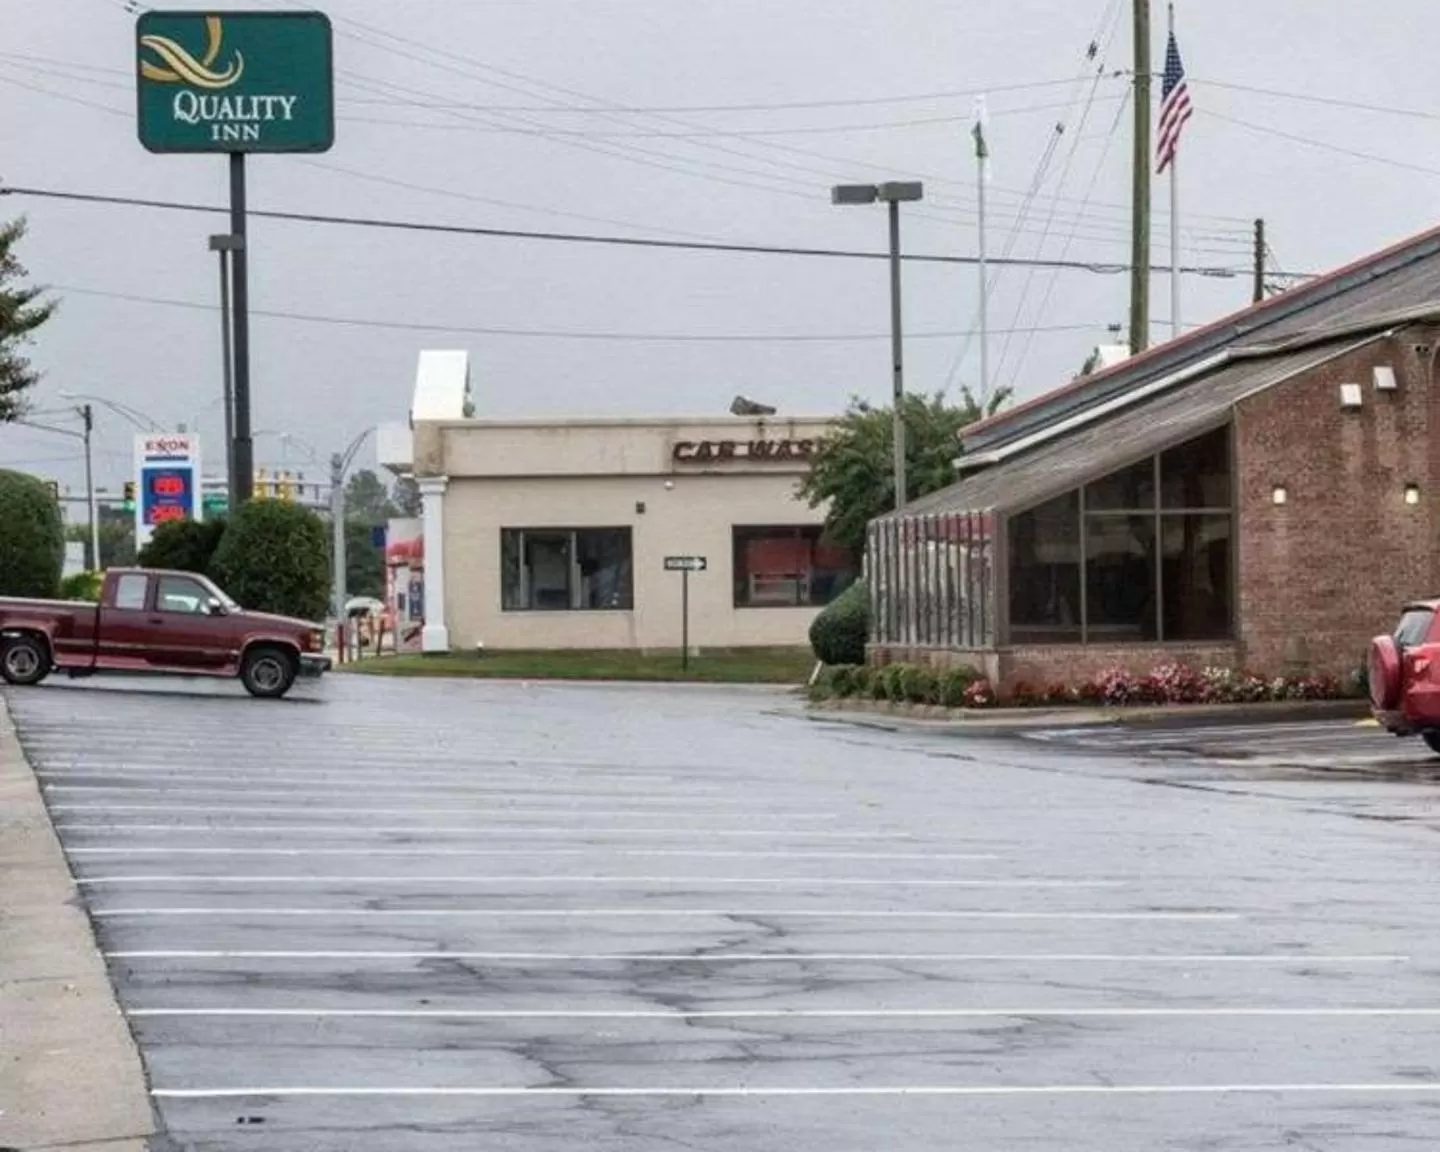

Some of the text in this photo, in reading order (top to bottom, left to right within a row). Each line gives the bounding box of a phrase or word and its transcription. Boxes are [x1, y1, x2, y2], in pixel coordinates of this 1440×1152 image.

[174, 90, 296, 123] QUALITY
[212, 124, 260, 141] INN
[674, 441, 736, 461] CAR
